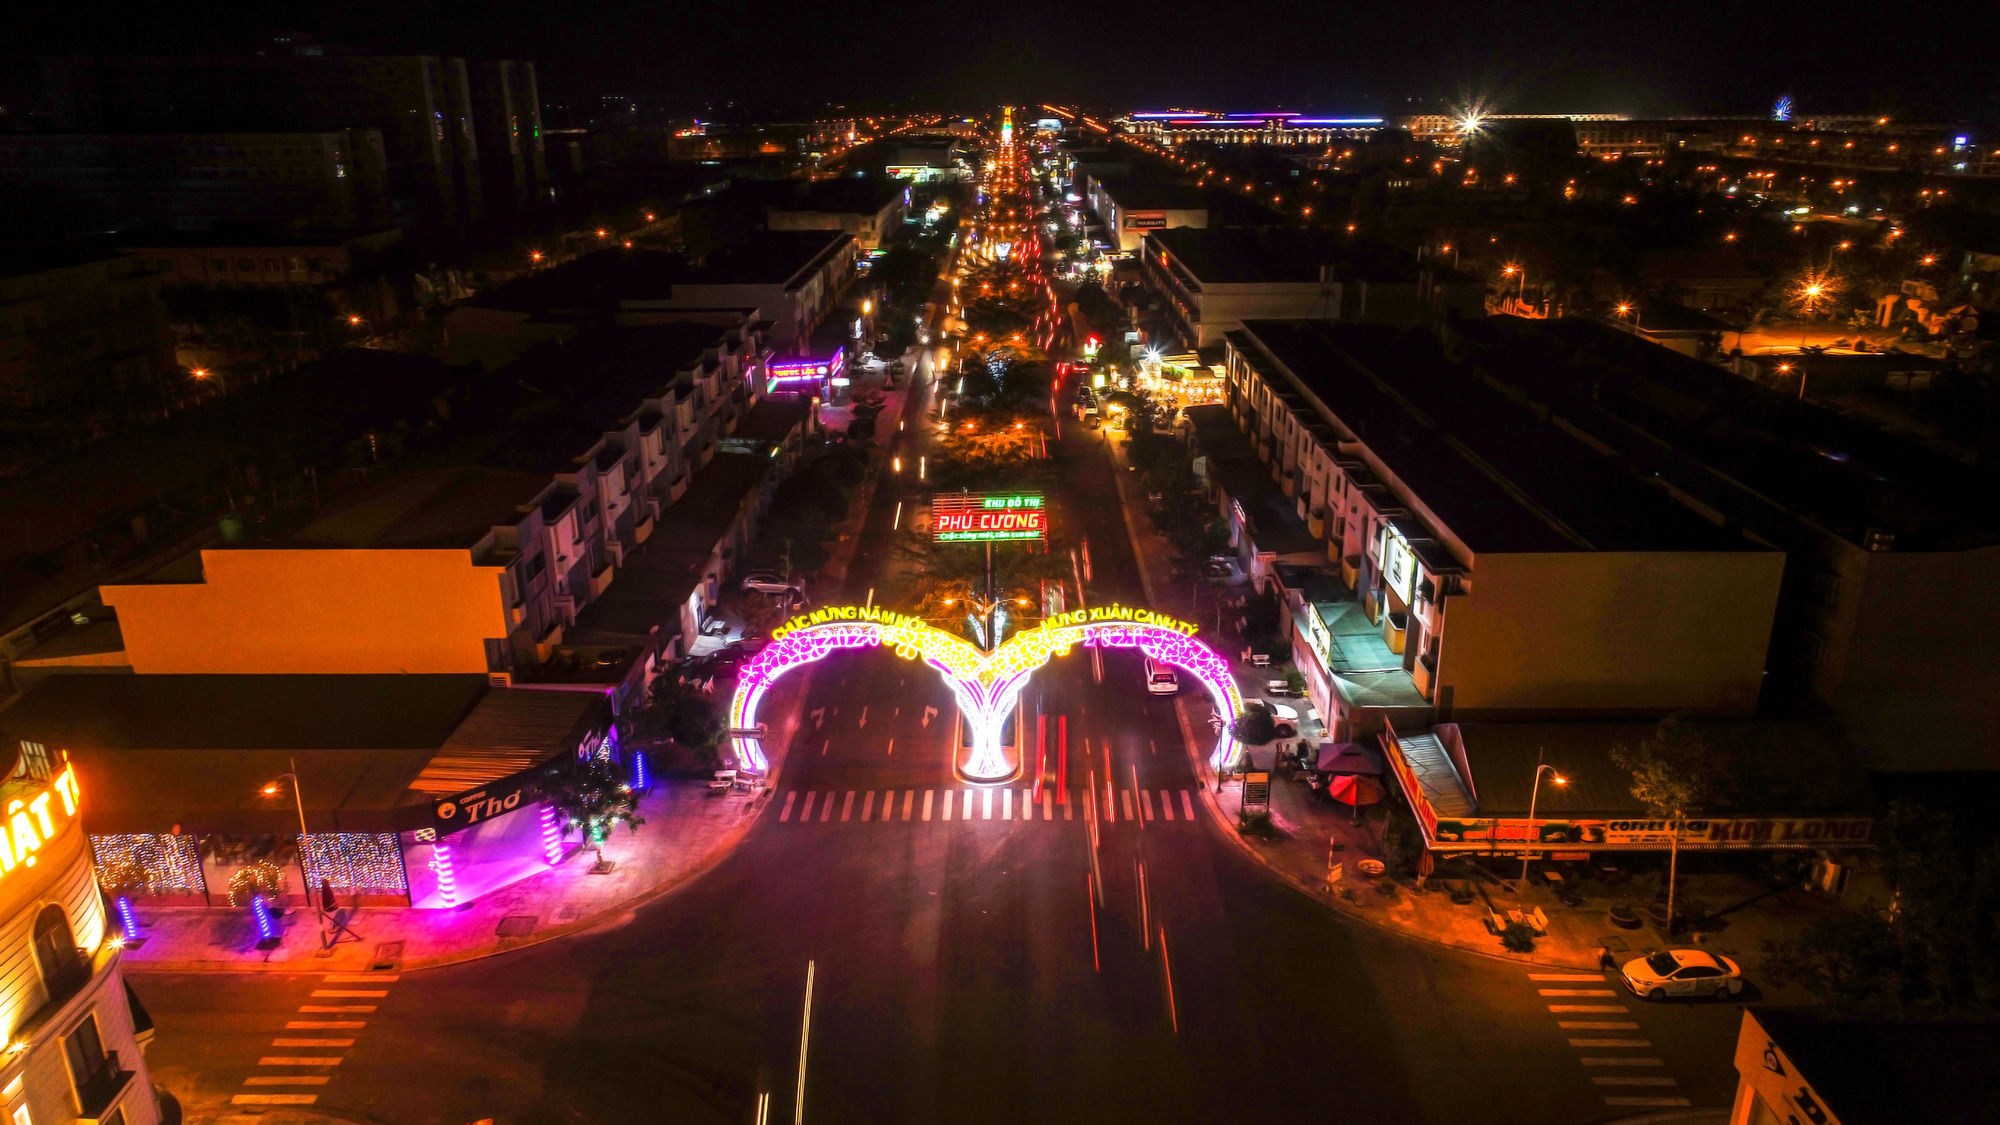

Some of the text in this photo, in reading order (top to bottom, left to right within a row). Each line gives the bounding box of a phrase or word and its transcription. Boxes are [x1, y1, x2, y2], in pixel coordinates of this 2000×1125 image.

[984, 496, 1040, 509] KHU ĐÔ THỊ
[938, 508, 1040, 530] PHÚ CƯỜNG
[772, 615, 811, 641] CHÚC
[809, 605, 857, 625] MỪNG
[858, 605, 896, 625] NĂM
[1089, 602, 1133, 621] XUÂN
[1134, 609, 1177, 630] CANH
[817, 627, 881, 647] 2020
[1609, 820, 1666, 831] COFFEE
[1710, 820, 1869, 841] KIM LONG
